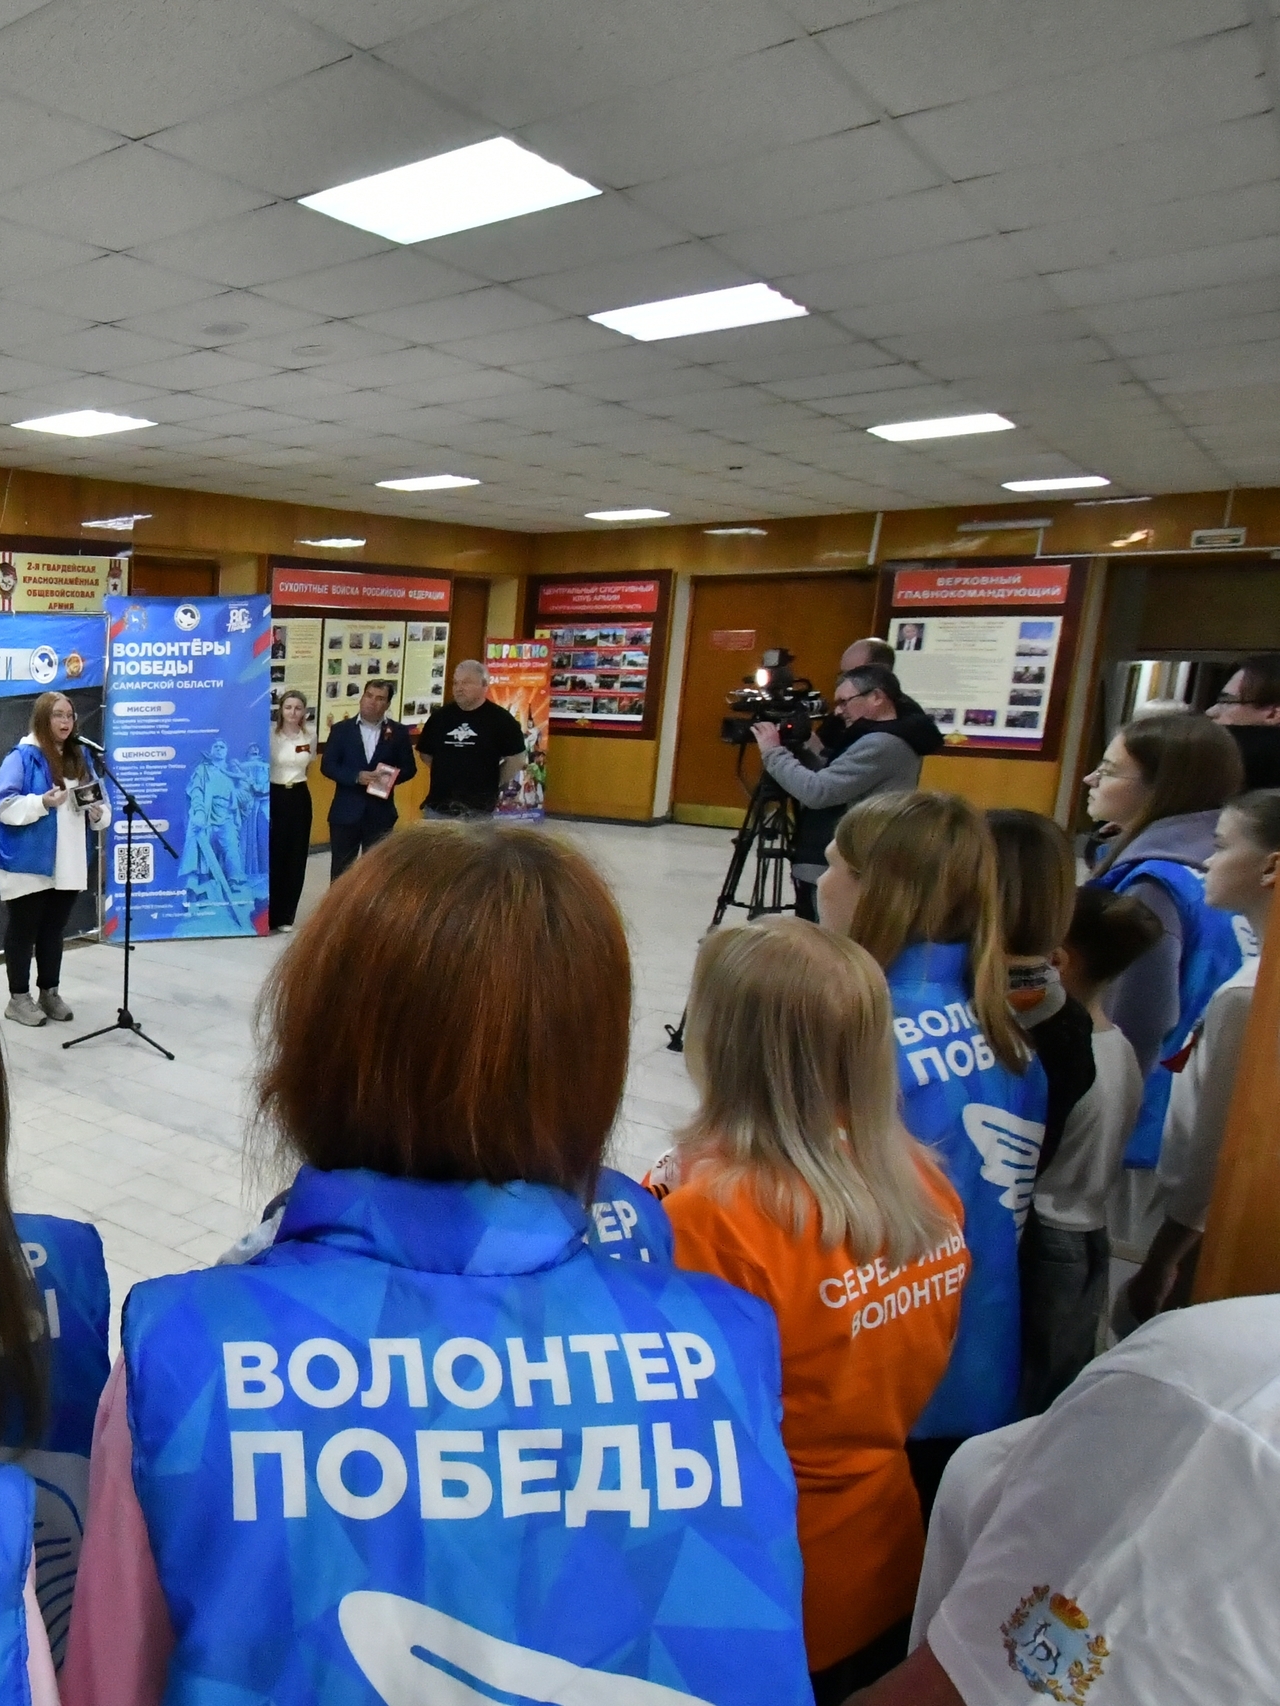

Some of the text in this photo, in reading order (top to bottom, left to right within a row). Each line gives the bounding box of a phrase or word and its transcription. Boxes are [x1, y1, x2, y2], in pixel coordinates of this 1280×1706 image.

[42, 563, 96, 573] ГВАРДЕЙСКАЯ
[22, 575, 100, 586] КРАСНОЗНАМЁННАЯ
[936, 574, 1023, 586] ВЕРХОВНЫЙ
[26, 588, 95, 598] ОБЩЕВОЙСКОВАЯ
[279, 581, 329, 595] СУХОПУТНЫЕ
[362, 586, 406, 598] РОССИЙСКОЙ
[408, 590, 445, 601] ФЕДЕРАЦИИ
[897, 586, 1062, 600] ГЛАВНОКОМАНДУЮЩИЙ
[48, 602, 74, 610] АРМИЯ
[112, 638, 231, 658] ВОЛОНТЁРЫ
[112, 660, 194, 677] ПОБЕДЫ
[112, 680, 224, 691] САМАРСКОЙ ОБЛАСТИ
[122, 751, 167, 759] ЦЕННОСТИ
[907, 1034, 996, 1086] ПОБ
[222, 1332, 716, 1410] ВОЛОНТЕР
[230, 1419, 743, 1529] ПОБЕДЫ
